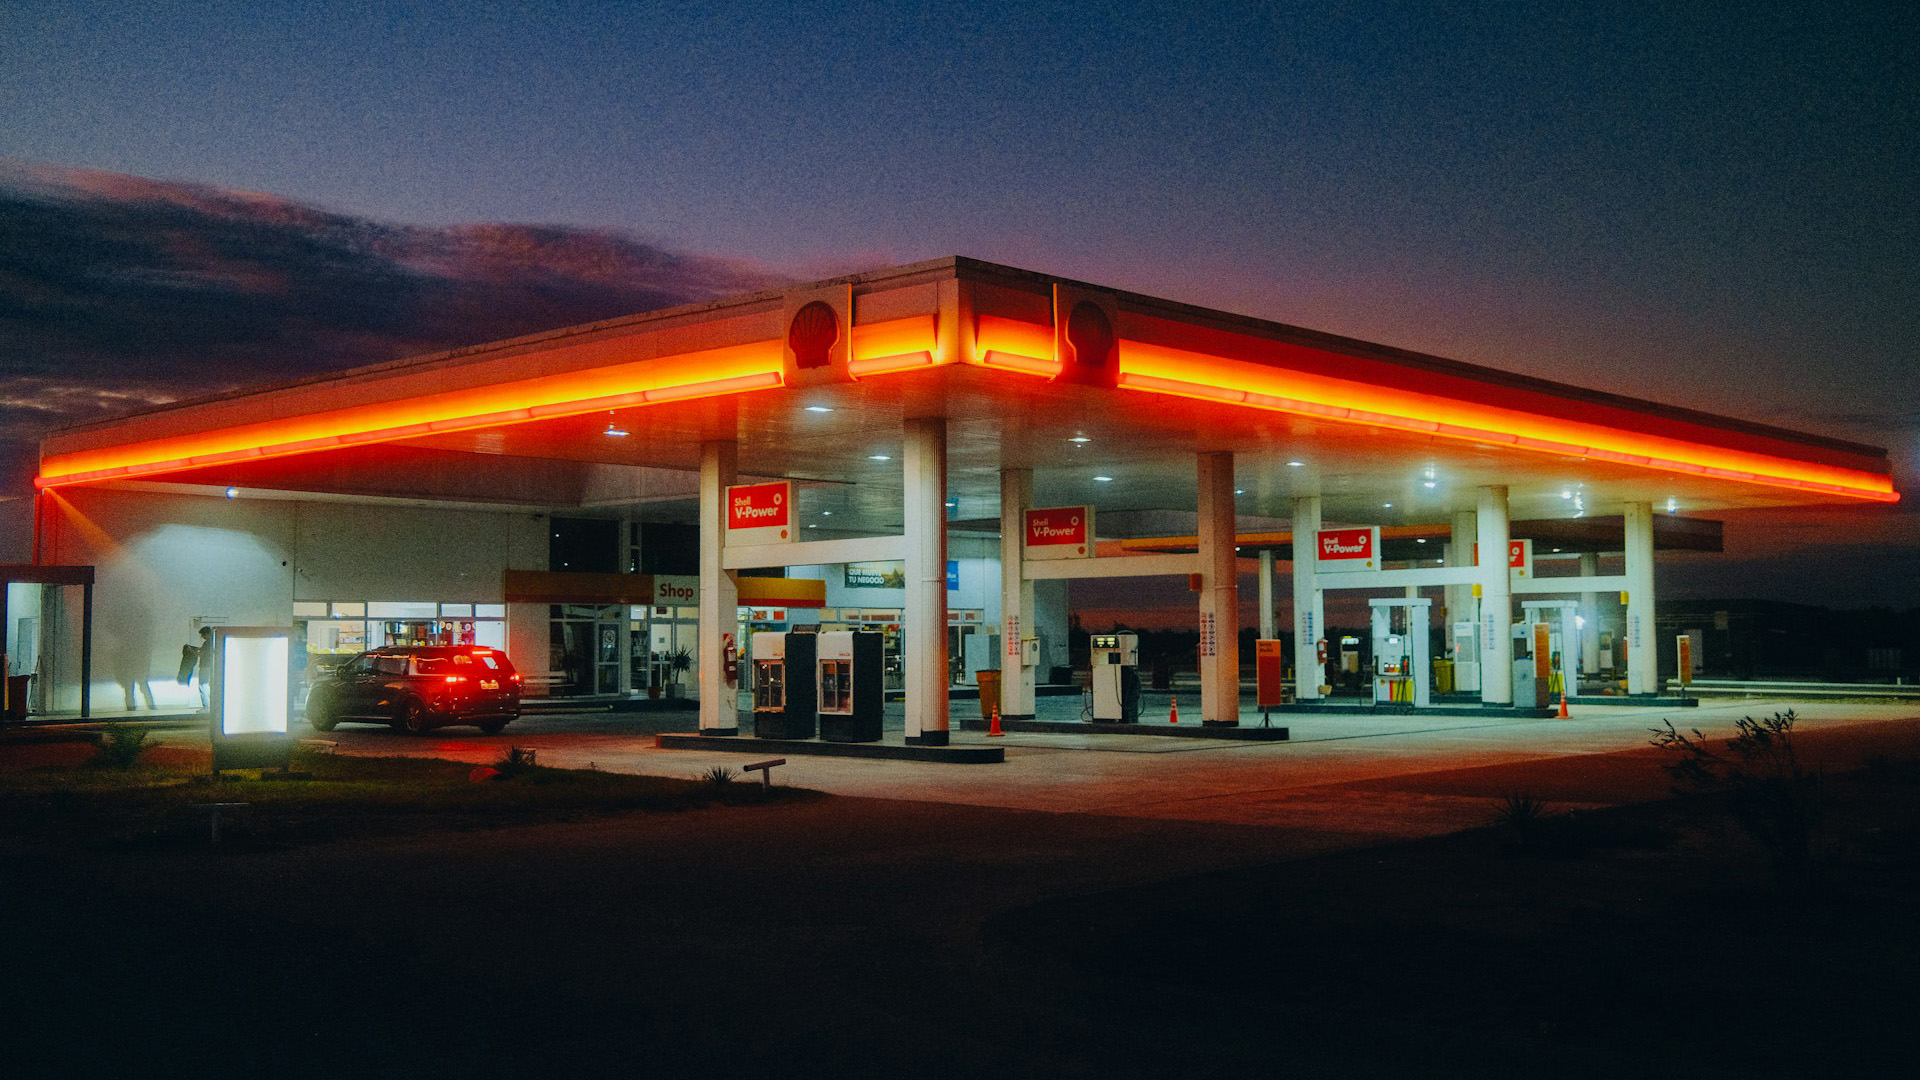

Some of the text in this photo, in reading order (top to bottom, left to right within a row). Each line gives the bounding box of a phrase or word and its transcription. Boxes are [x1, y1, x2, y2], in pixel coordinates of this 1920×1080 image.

[735, 496, 751, 507] Shell
[735, 506, 779, 519] V-Power
[1032, 518, 1049, 527] Shell
[1033, 526, 1076, 538] V-Power
[1324, 544, 1364, 554] V-Power
[857, 576, 885, 584] NEGOCIO
[660, 583, 694, 601] Shop
